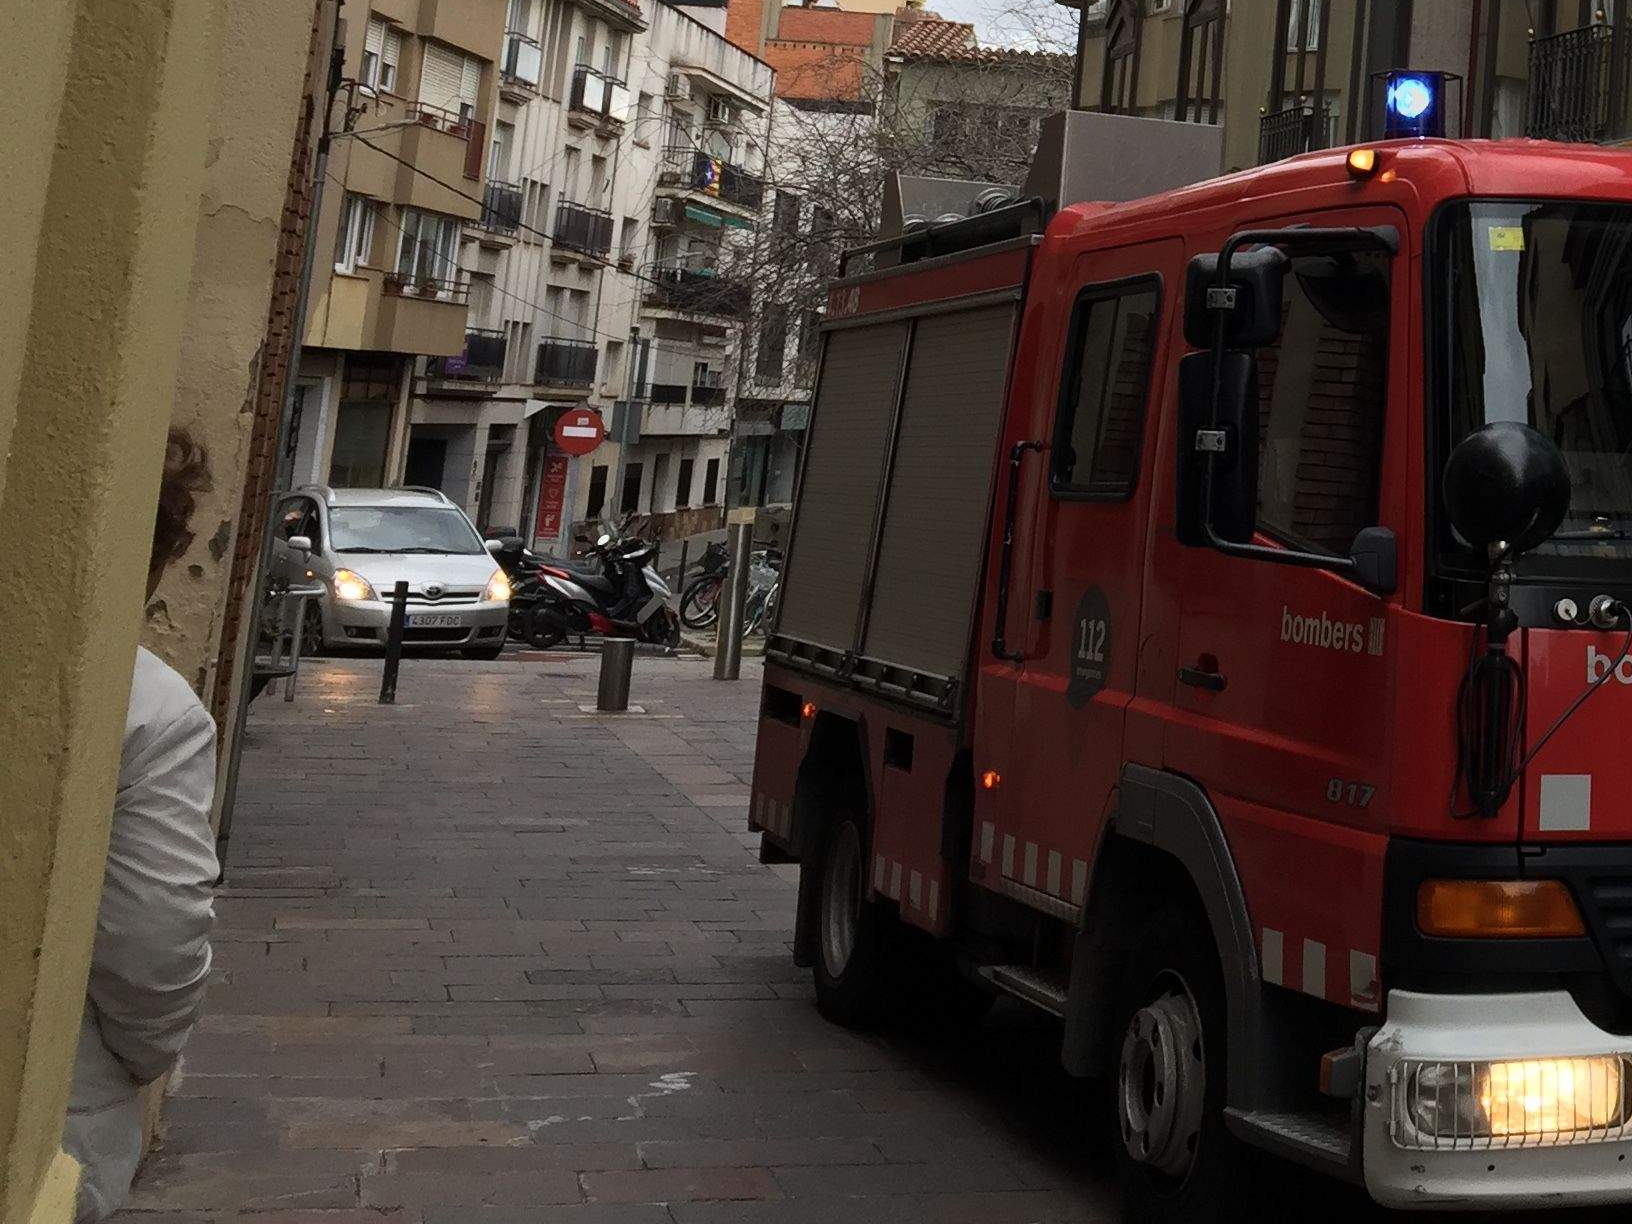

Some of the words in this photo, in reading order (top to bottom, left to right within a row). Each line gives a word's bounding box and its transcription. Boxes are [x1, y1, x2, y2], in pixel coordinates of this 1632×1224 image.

[412, 616, 438, 625] 4307
[1280, 605, 1364, 654] bombers
[1078, 618, 1105, 662] 112
[1327, 778, 1376, 807] 817
